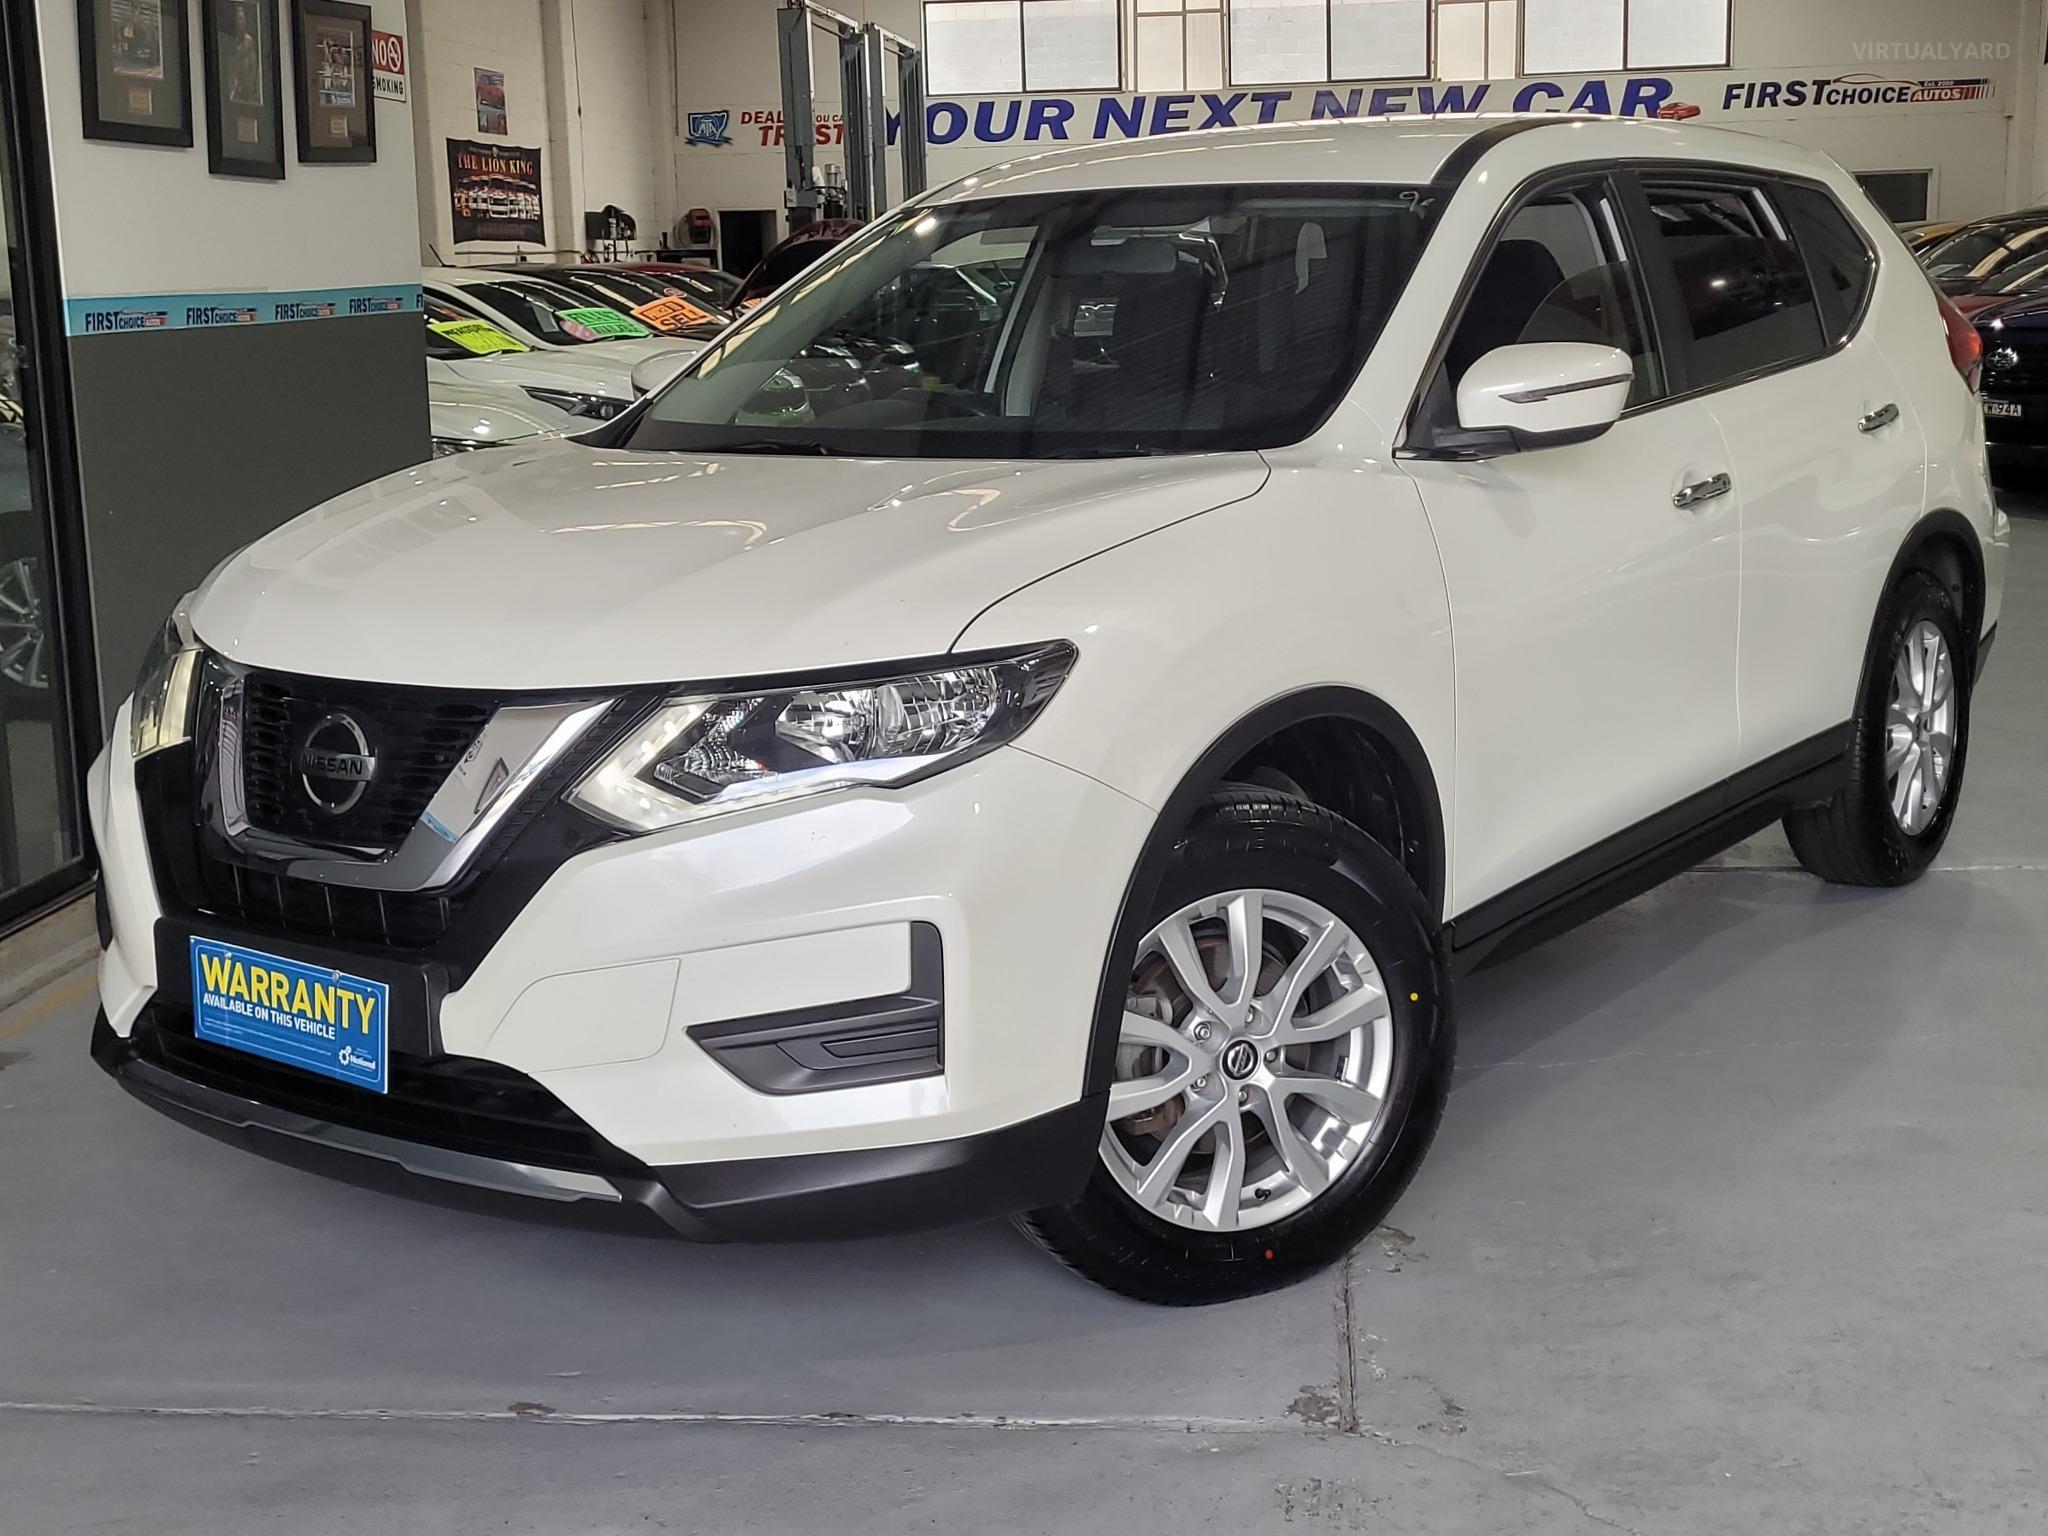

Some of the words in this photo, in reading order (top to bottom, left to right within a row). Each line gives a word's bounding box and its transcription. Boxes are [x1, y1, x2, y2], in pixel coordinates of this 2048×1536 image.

[372, 38, 387, 66] NO
[1722, 79, 1832, 110] FIRST
[1826, 86, 1910, 105] CHOICE
[1912, 88, 1962, 101] AUTOS
[741, 111, 784, 124] DEAL
[816, 115, 830, 123] OU
[1093, 91, 1292, 139] NEXT
[1311, 84, 1490, 120] NEW
[1513, 78, 1673, 119] CAR
[458, 153, 477, 170] THE
[482, 157, 506, 173] LION
[509, 159, 533, 175] KING
[187, 307, 217, 325] FIRST
[275, 303, 302, 320] FIRST
[349, 297, 373, 314] FIRST
[85, 311, 121, 332] FIRST
[119, 316, 145, 329] CHOICE
[303, 754, 363, 776] NISSAN
[201, 954, 376, 1035] WARRANTY
[203, 993, 253, 1017] AVAILABLE
[255, 1006, 269, 1021] ON
[270, 1010, 293, 1028] THIS
[294, 1017, 336, 1040] VEHICLE
